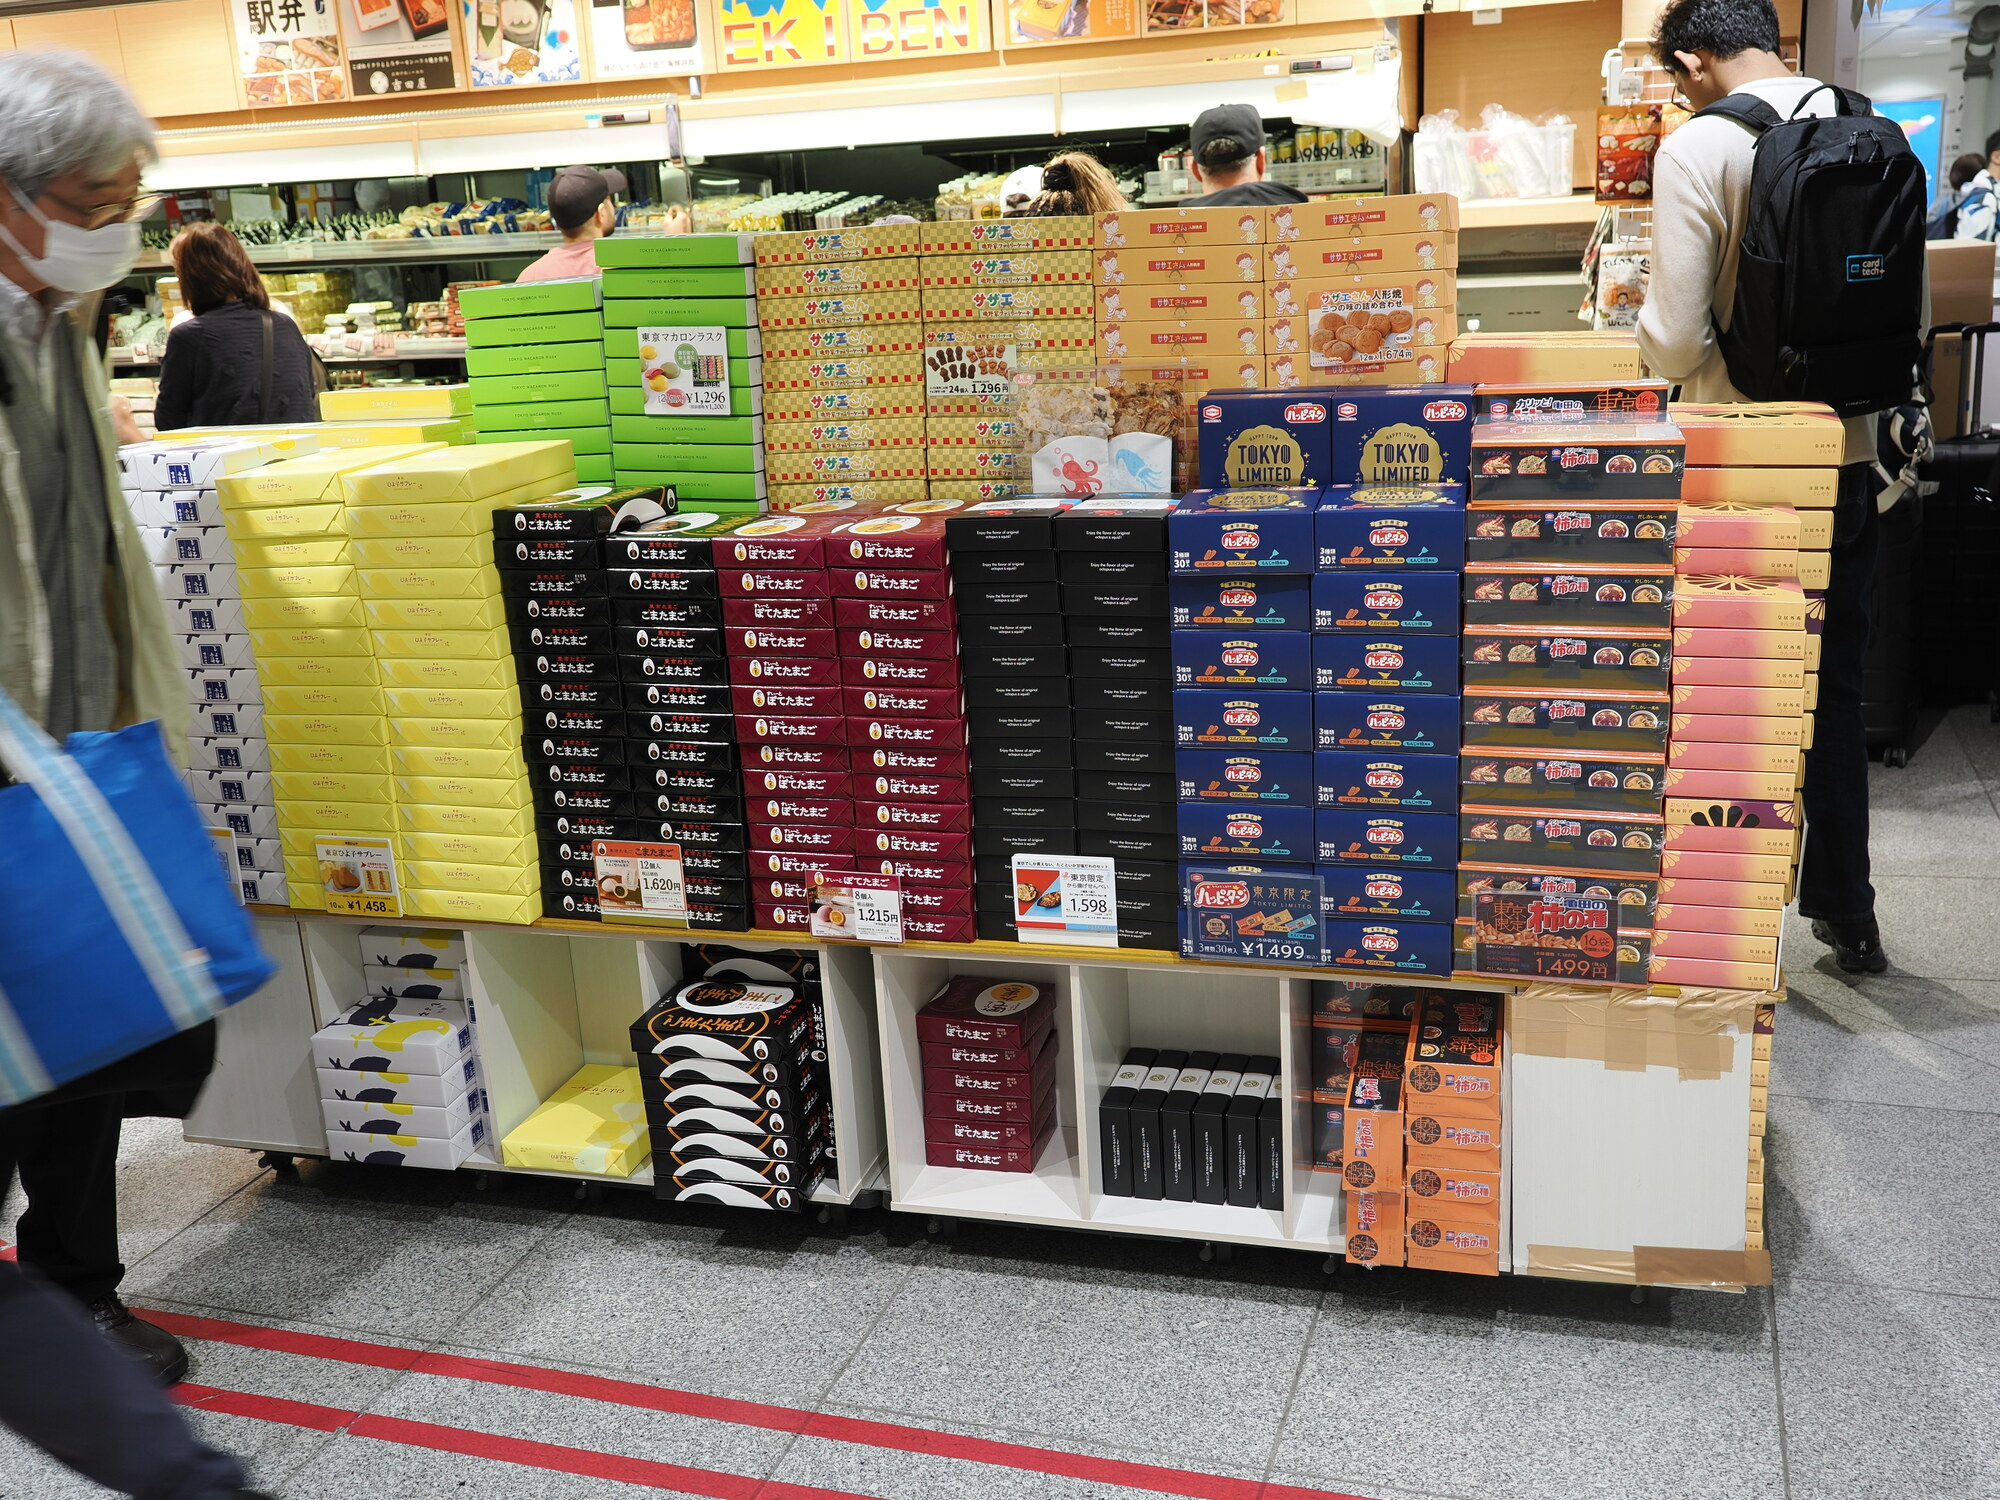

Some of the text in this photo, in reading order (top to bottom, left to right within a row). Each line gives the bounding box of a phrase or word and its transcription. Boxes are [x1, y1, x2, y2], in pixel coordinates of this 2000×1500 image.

[248, 0, 306, 35] 駅弁
[1333, 214, 1364, 224] サザエさん
[972, 224, 1039, 240] サザエさん
[1157, 224, 1187, 232] サザエさん
[803, 232, 867, 250] サザエさん
[1330, 252, 1361, 262] サザエさん
[1862, 258, 1880, 268] card
[971, 258, 1038, 274] サザエさん
[1155, 261, 1185, 270] サザエさん
[1862, 267, 1885, 276] tech+
[803, 266, 866, 282] サザエさん
[973, 291, 1040, 307] サザエさん
[1321, 289, 1402, 303] サザエさん 人形焼
[805, 298, 869, 315] サザエさん
[1322, 300, 1402, 313] 三つの味の詰め合わせ
[642, 332, 722, 342] 東京マカロンラスク
[927, 331, 974, 342] サザエさん
[810, 361, 872, 378] サザエさん
[949, 385, 969, 393] 24個入
[687, 391, 726, 404] ¥1,296
[1552, 400, 1583, 409] 亀田の
[1238, 444, 1291, 464] TOKYO
[1374, 443, 1429, 464] TOKYO
[1561, 452, 1598, 467] 柿の種
[812, 455, 874, 471] サザエさん
[1238, 467, 1291, 482] LIMITED
[1373, 466, 1429, 482] LIMITED
[528, 518, 572, 530] ごまたまご
[1554, 516, 1592, 533] 柿の種
[1372, 534, 1407, 543] ハッピーターン
[530, 548, 573, 560] ごまたまご
[641, 548, 687, 560] ごまたまご
[749, 549, 796, 560] ぽてたまご
[865, 547, 915, 559] ぽてたまご
[530, 580, 574, 592] ごまたまご
[755, 580, 804, 590] ぽてたまご
[1222, 593, 1256, 606] ハッピーターン
[541, 606, 585, 617] ごまたまご
[874, 638, 923, 649] ぽてたまご
[1549, 642, 1586, 658] 柿の種
[1224, 651, 1258, 666] ハッピーターン
[1366, 655, 1403, 668] ハッピーターン
[1228, 770, 1260, 782] ハッピーターン
[1545, 765, 1582, 780] 柿の種
[1229, 825, 1262, 838] ハッピーターン
[1544, 823, 1580, 838] 柿の種
[325, 849, 382, 858] 東京ひよ子サブレー
[635, 846, 674, 857] ごまたまご
[640, 861, 661, 870] 12個入
[844, 877, 890, 887] ぽてたまご
[1070, 874, 1104, 882] 東京限定
[644, 878, 681, 891] 1,620円
[855, 891, 873, 900] 8個入
[1197, 886, 1311, 905] ハッピーターン 東京限定
[347, 900, 386, 912] ¥1,458
[1494, 901, 1528, 919] 東京
[1564, 899, 1606, 910] 亀田の
[859, 908, 898, 922] 1,215円
[1528, 901, 1608, 934] 柿の種
[1495, 918, 1526, 932] 限定
[1584, 935, 1609, 946] 16袋
[1199, 943, 1238, 954] 3種類30枚入
[1241, 942, 1304, 959] ¥1,499
[946, 1028, 991, 1041] ぽてたまご
[1455, 1081, 1489, 1092] 柿の種
[1455, 1133, 1490, 1145] 柿の種
[955, 1153, 1002, 1165] ぽてたまご
[1455, 1236, 1489, 1248] 柿の種
